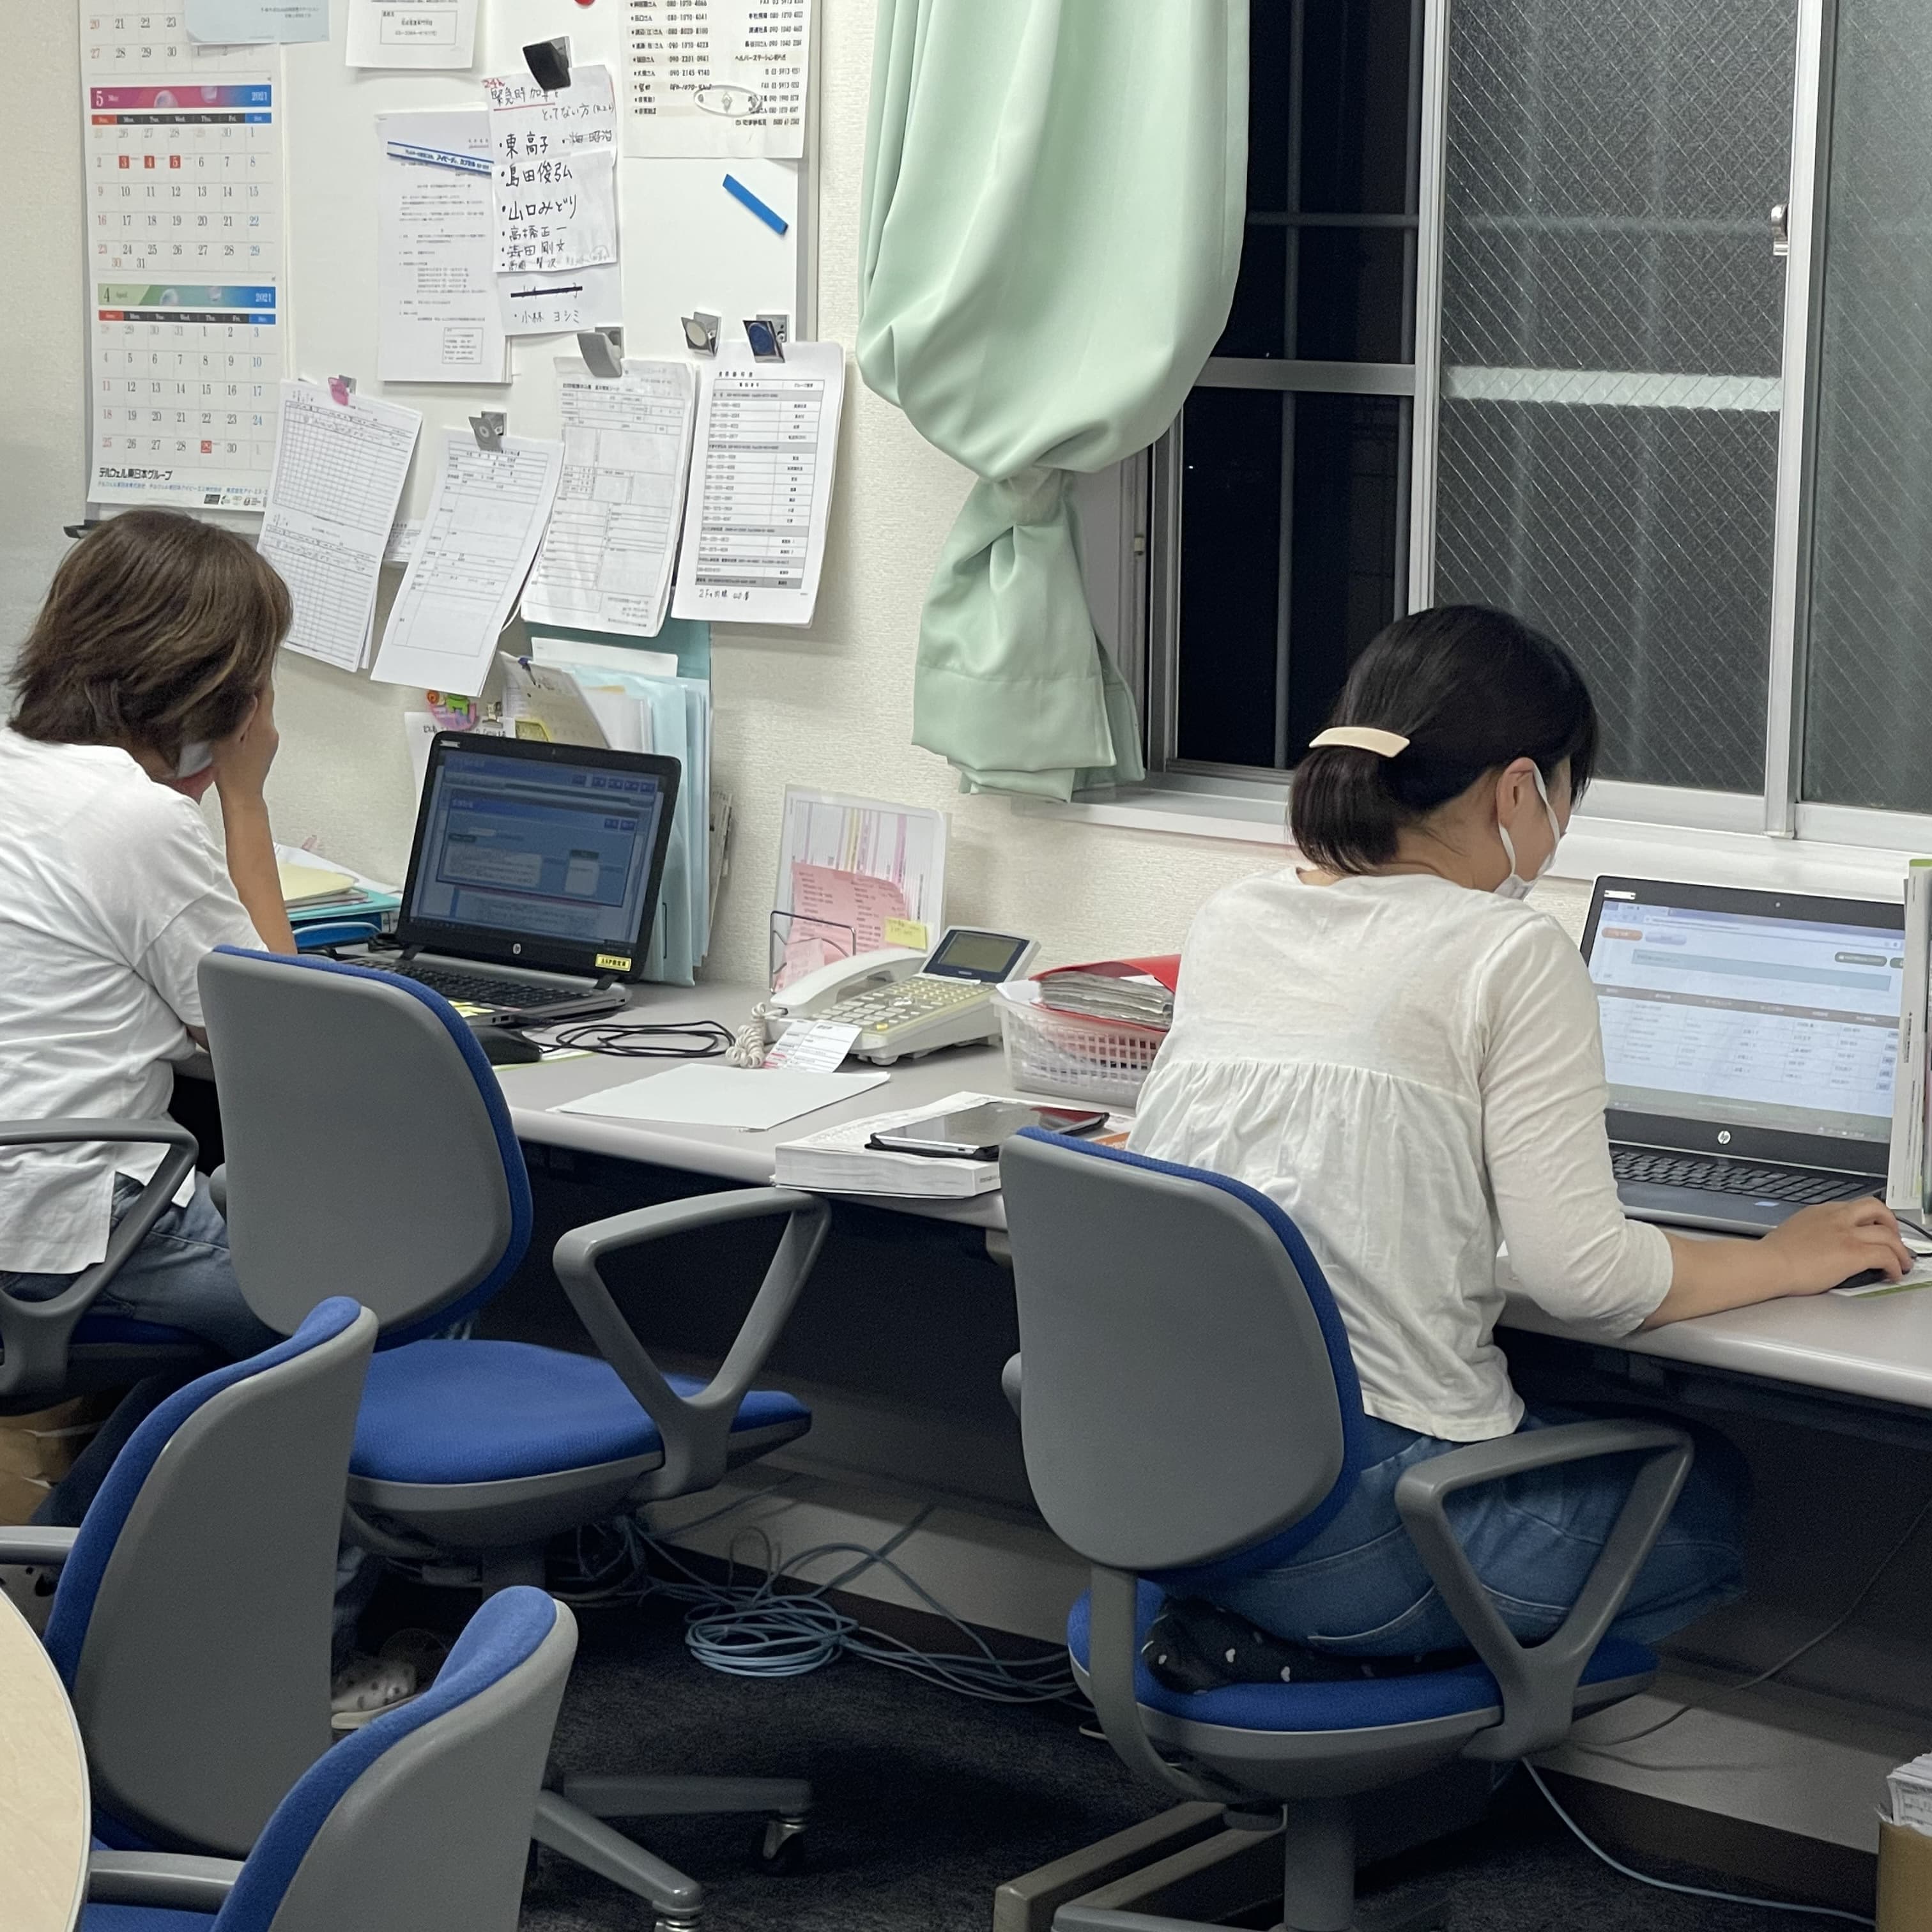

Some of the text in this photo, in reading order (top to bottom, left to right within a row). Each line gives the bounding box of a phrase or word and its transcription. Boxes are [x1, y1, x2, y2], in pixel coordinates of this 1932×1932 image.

[90, 18, 176, 29] 20 21 22 23
[91, 48, 100, 58] 27
[116, 48, 125, 58] 28
[141, 47, 151, 57] 29
[167, 47, 176, 57] 30
[96, 91, 103, 106] 5
[251, 92, 267, 101] 2021
[119, 128, 128, 138] 26
[144, 128, 153, 137] 27
[170, 128, 180, 137] 28
[222, 128, 231, 137] 30
[250, 127, 254, 137] 1
[97, 157, 102, 167] 2
[199, 157, 204, 167] 6
[225, 157, 229, 167] 7
[250, 157, 256, 167] 8
[98, 187, 258, 197] 9 10 11 12 13 14 15
[98, 216, 259, 226] 16 17 18 19 20 21 22
[98, 244, 259, 256] 23 24 25 26 27 28 29
[112, 258, 145, 268] 30 31
[103, 288, 110, 302] 4
[256, 293, 272, 302] 2021
[150, 325, 158, 335] 30
[175, 326, 183, 335] 31
[203, 326, 206, 337] 1
[228, 327, 233, 337] 2
[254, 328, 258, 337] 3
[128, 353, 132, 363] 5
[152, 354, 157, 364] 6
[178, 355, 183, 364] 7
[203, 355, 208, 365] 8
[229, 356, 234, 366] 9
[253, 356, 262, 367] 10
[103, 381, 261, 396] 11 12 13 14 15 16 17
[103, 410, 263, 425] 18 19 20 21 22 23 24
[103, 438, 112, 448] 25
[127, 439, 136, 448] 26
[151, 440, 160, 450] 27
[177, 441, 186, 451] 28
[227, 443, 237, 453] 30
[99, 467, 172, 480] テルウェル東日本グループ
